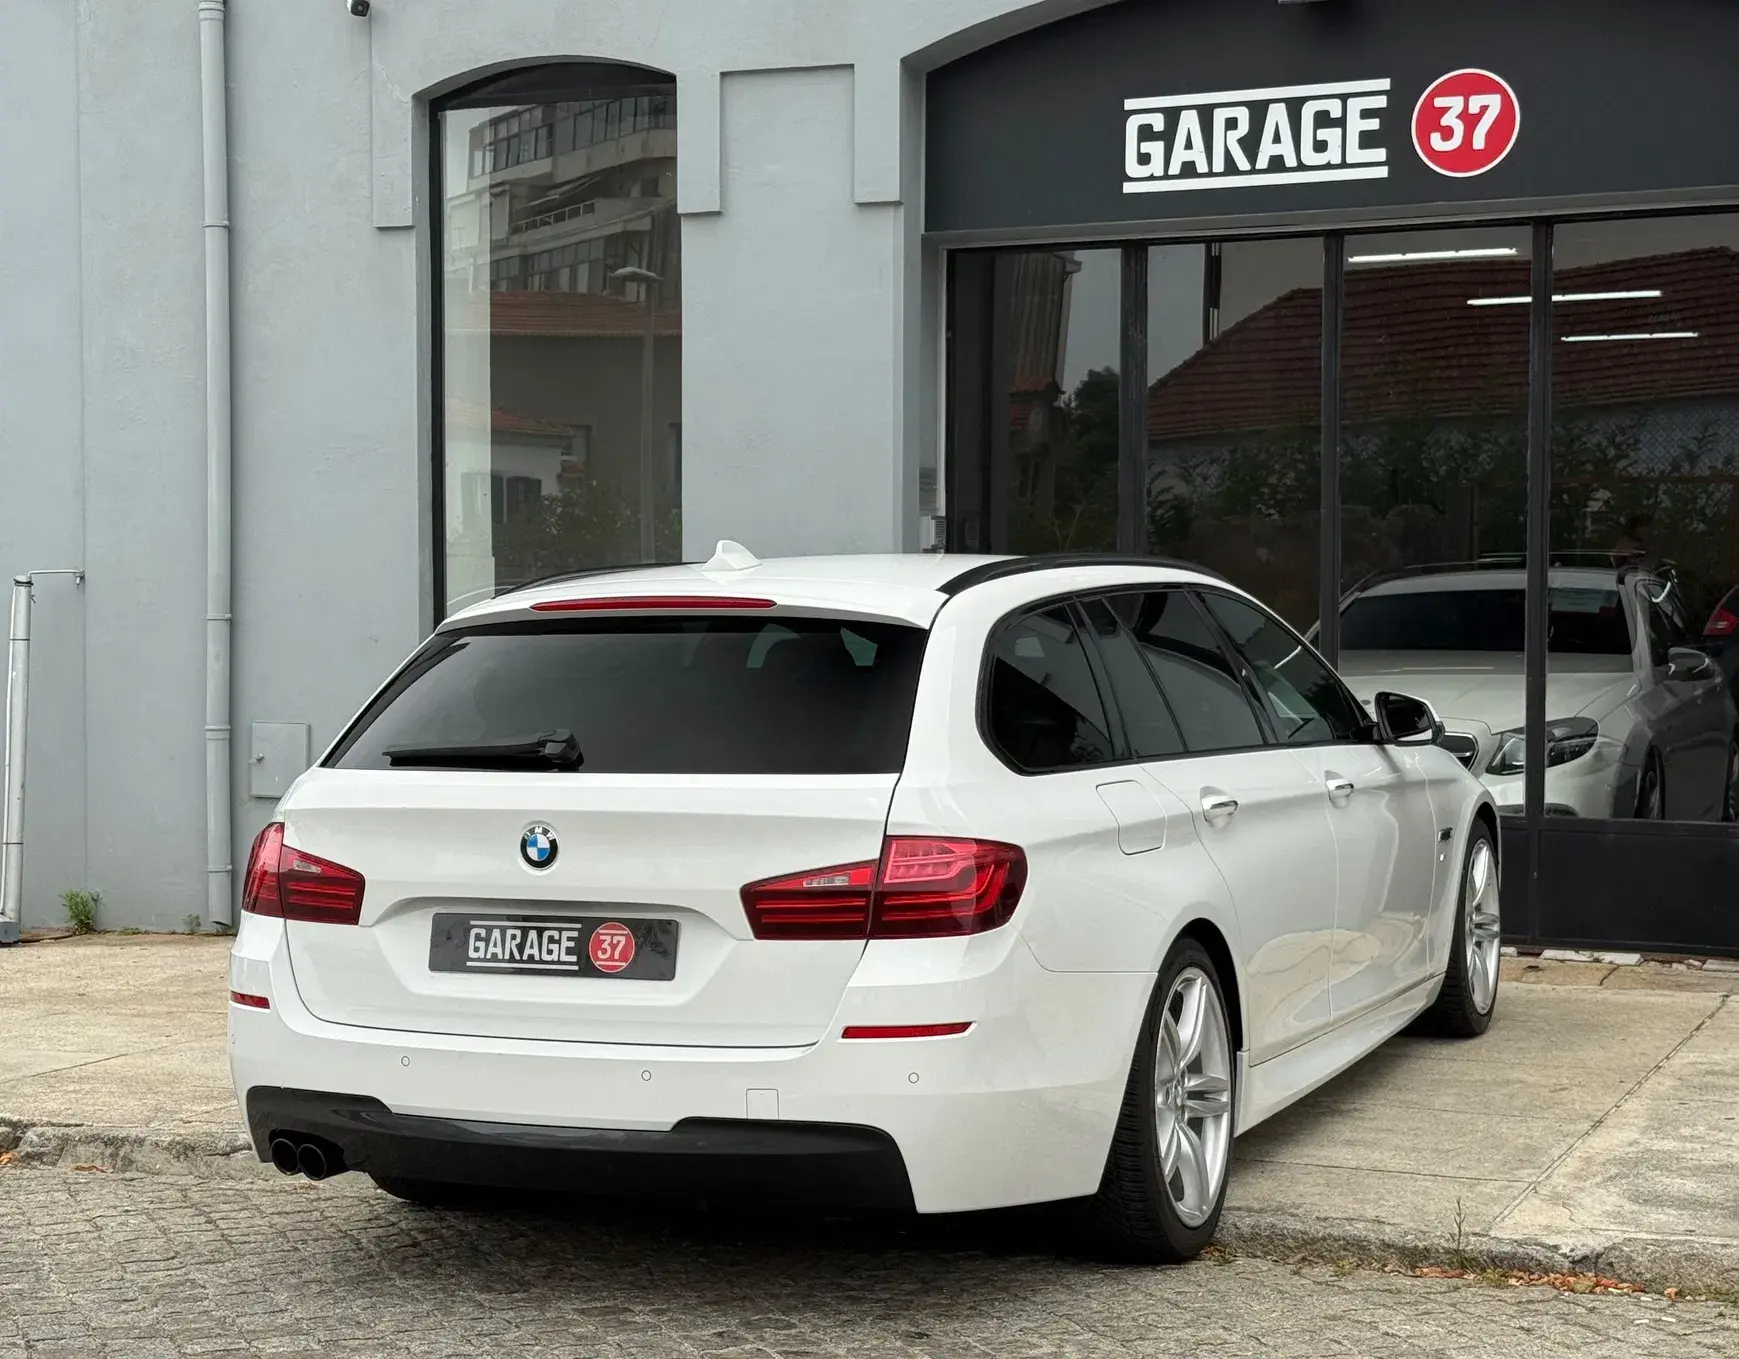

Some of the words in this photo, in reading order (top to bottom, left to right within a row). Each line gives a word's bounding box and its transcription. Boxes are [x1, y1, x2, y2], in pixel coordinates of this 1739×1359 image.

[1125, 95, 1387, 178] GARAGE
[1429, 94, 1501, 152] 37
[468, 928, 578, 962] GARAGE
[597, 935, 626, 960] 37
